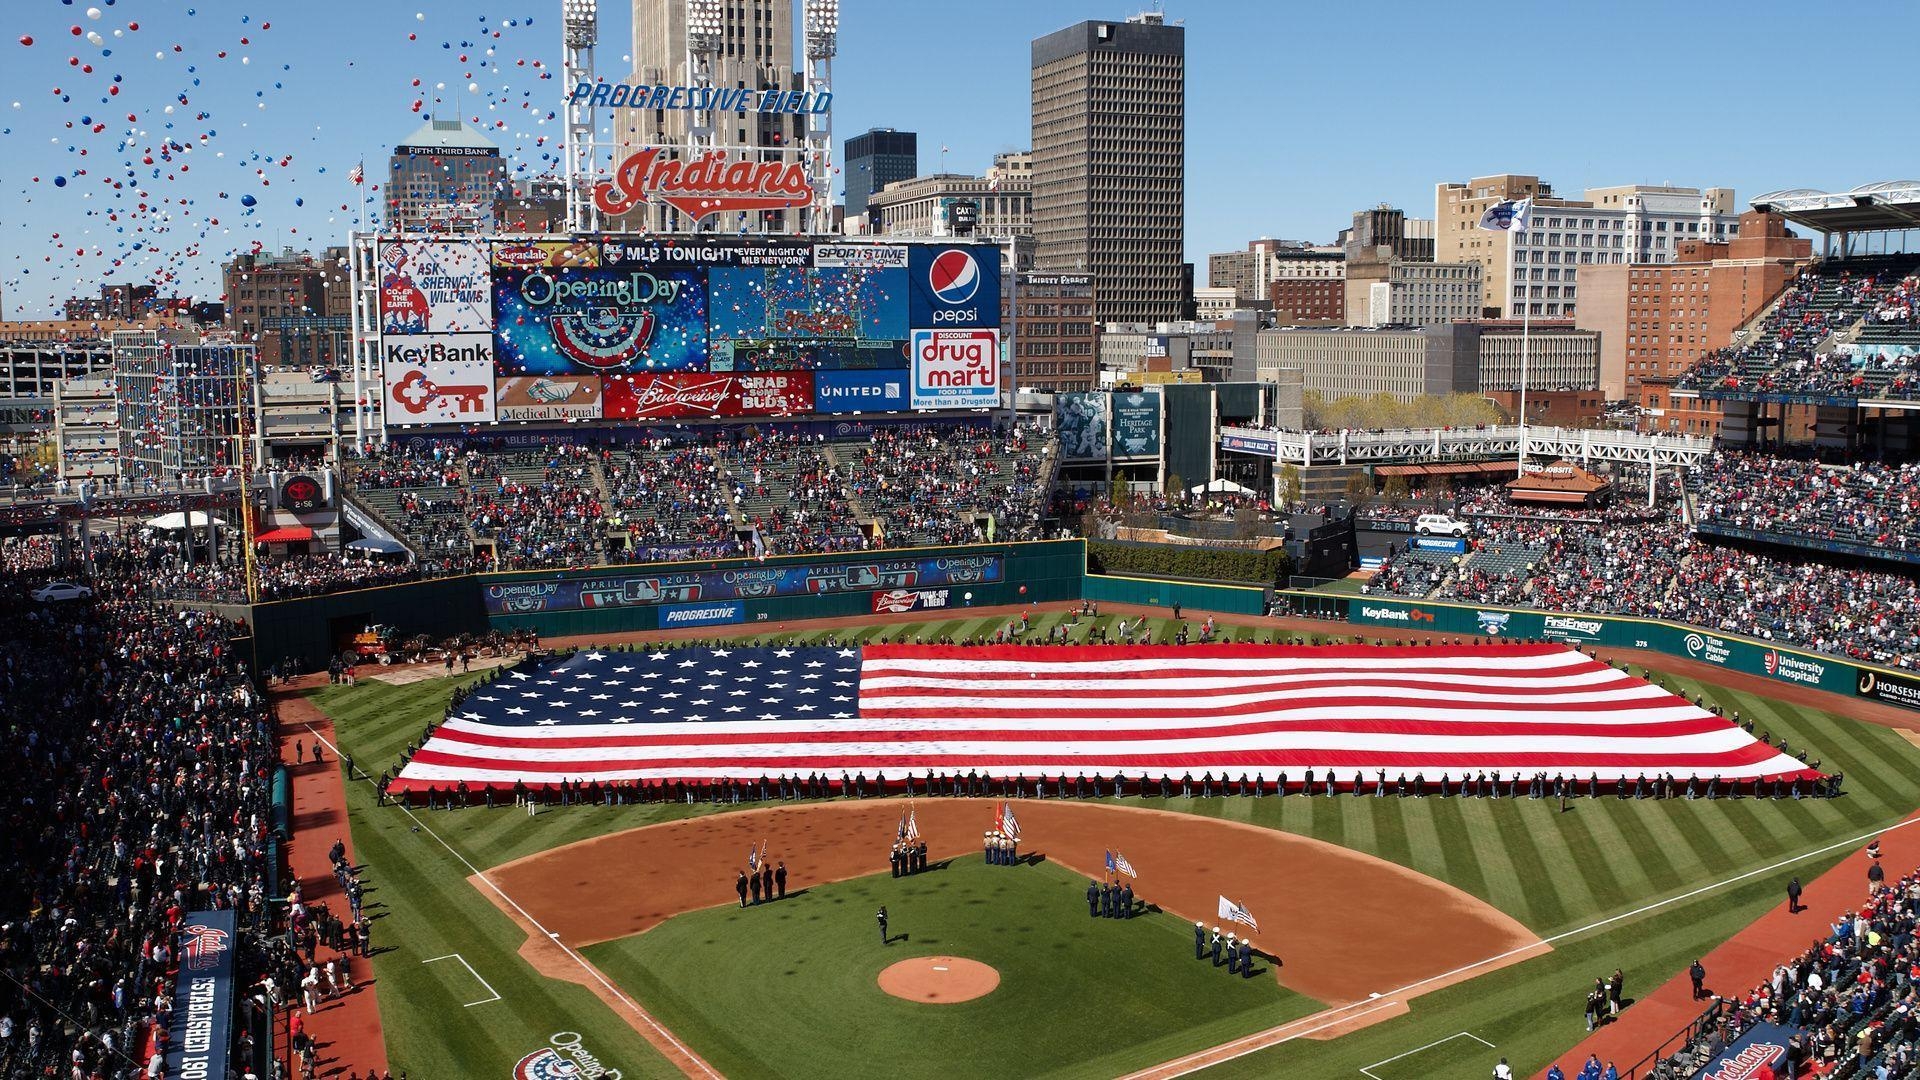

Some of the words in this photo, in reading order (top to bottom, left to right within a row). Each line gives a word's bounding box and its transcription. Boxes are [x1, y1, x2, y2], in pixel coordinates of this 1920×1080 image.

[569, 83, 754, 112] PROGRESSIVE
[758, 89, 833, 114] FIELD
[594, 147, 813, 216] Indians
[498, 249, 547, 263] Sugardale
[626, 247, 660, 261] MLB
[664, 247, 733, 261] TONIGHT
[738, 248, 767, 256] EVERY
[768, 248, 797, 256] NIGHT
[798, 248, 810, 256] ON
[741, 256, 760, 264] MLB
[761, 256, 806, 264] NETWORK
[417, 263, 440, 275] ASK
[422, 277, 478, 290] SHERWN-
[933, 307, 978, 325] pepsi
[387, 343, 489, 367] KeyBank
[922, 334, 982, 368] drug
[742, 377, 788, 389] GRAB
[928, 366, 991, 387] mart
[634, 387, 730, 405] Budweiser
[749, 388, 781, 396] SOME
[821, 386, 882, 397] UNITED
[742, 396, 788, 409] BUDS
[913, 398, 932, 406] More
[934, 398, 951, 406] than
[961, 397, 998, 406] Drugstore
[504, 406, 550, 420] Medical
[554, 406, 595, 420] Mutual
[1120, 418, 1153, 427] HERITAGE
[496, 435, 527, 446] ABLE
[1545, 466, 1573, 474] JOBSITE
[1371, 521, 1392, 530] 2:56
[1394, 523, 1410, 531] PM
[1417, 540, 1458, 548] PROGRESSIVE
[809, 566, 842, 575] APRIL
[885, 562, 916, 570] 2012
[582, 580, 620, 590] APRIL
[666, 575, 701, 584] 2012
[920, 590, 949, 600] WALK-OFF
[929, 598, 946, 607] HERO
[667, 607, 737, 622] PROGRESSIVE
[757, 612, 768, 620] 370
[1362, 607, 1409, 621] KeyBank
[1545, 616, 1603, 633] FirstEnergy
[1635, 640, 1648, 648] 375
[1706, 636, 1723, 647] Time
[1705, 644, 1731, 656] Warner
[1705, 652, 1725, 664] Cable
[1779, 655, 1825, 676] University
[1778, 666, 1820, 684] Hospitals
[1876, 680, 1920, 699] HORSESH
[185, 976, 215, 1053] ESTABLISHED
[180, 1055, 209, 1080] 190
